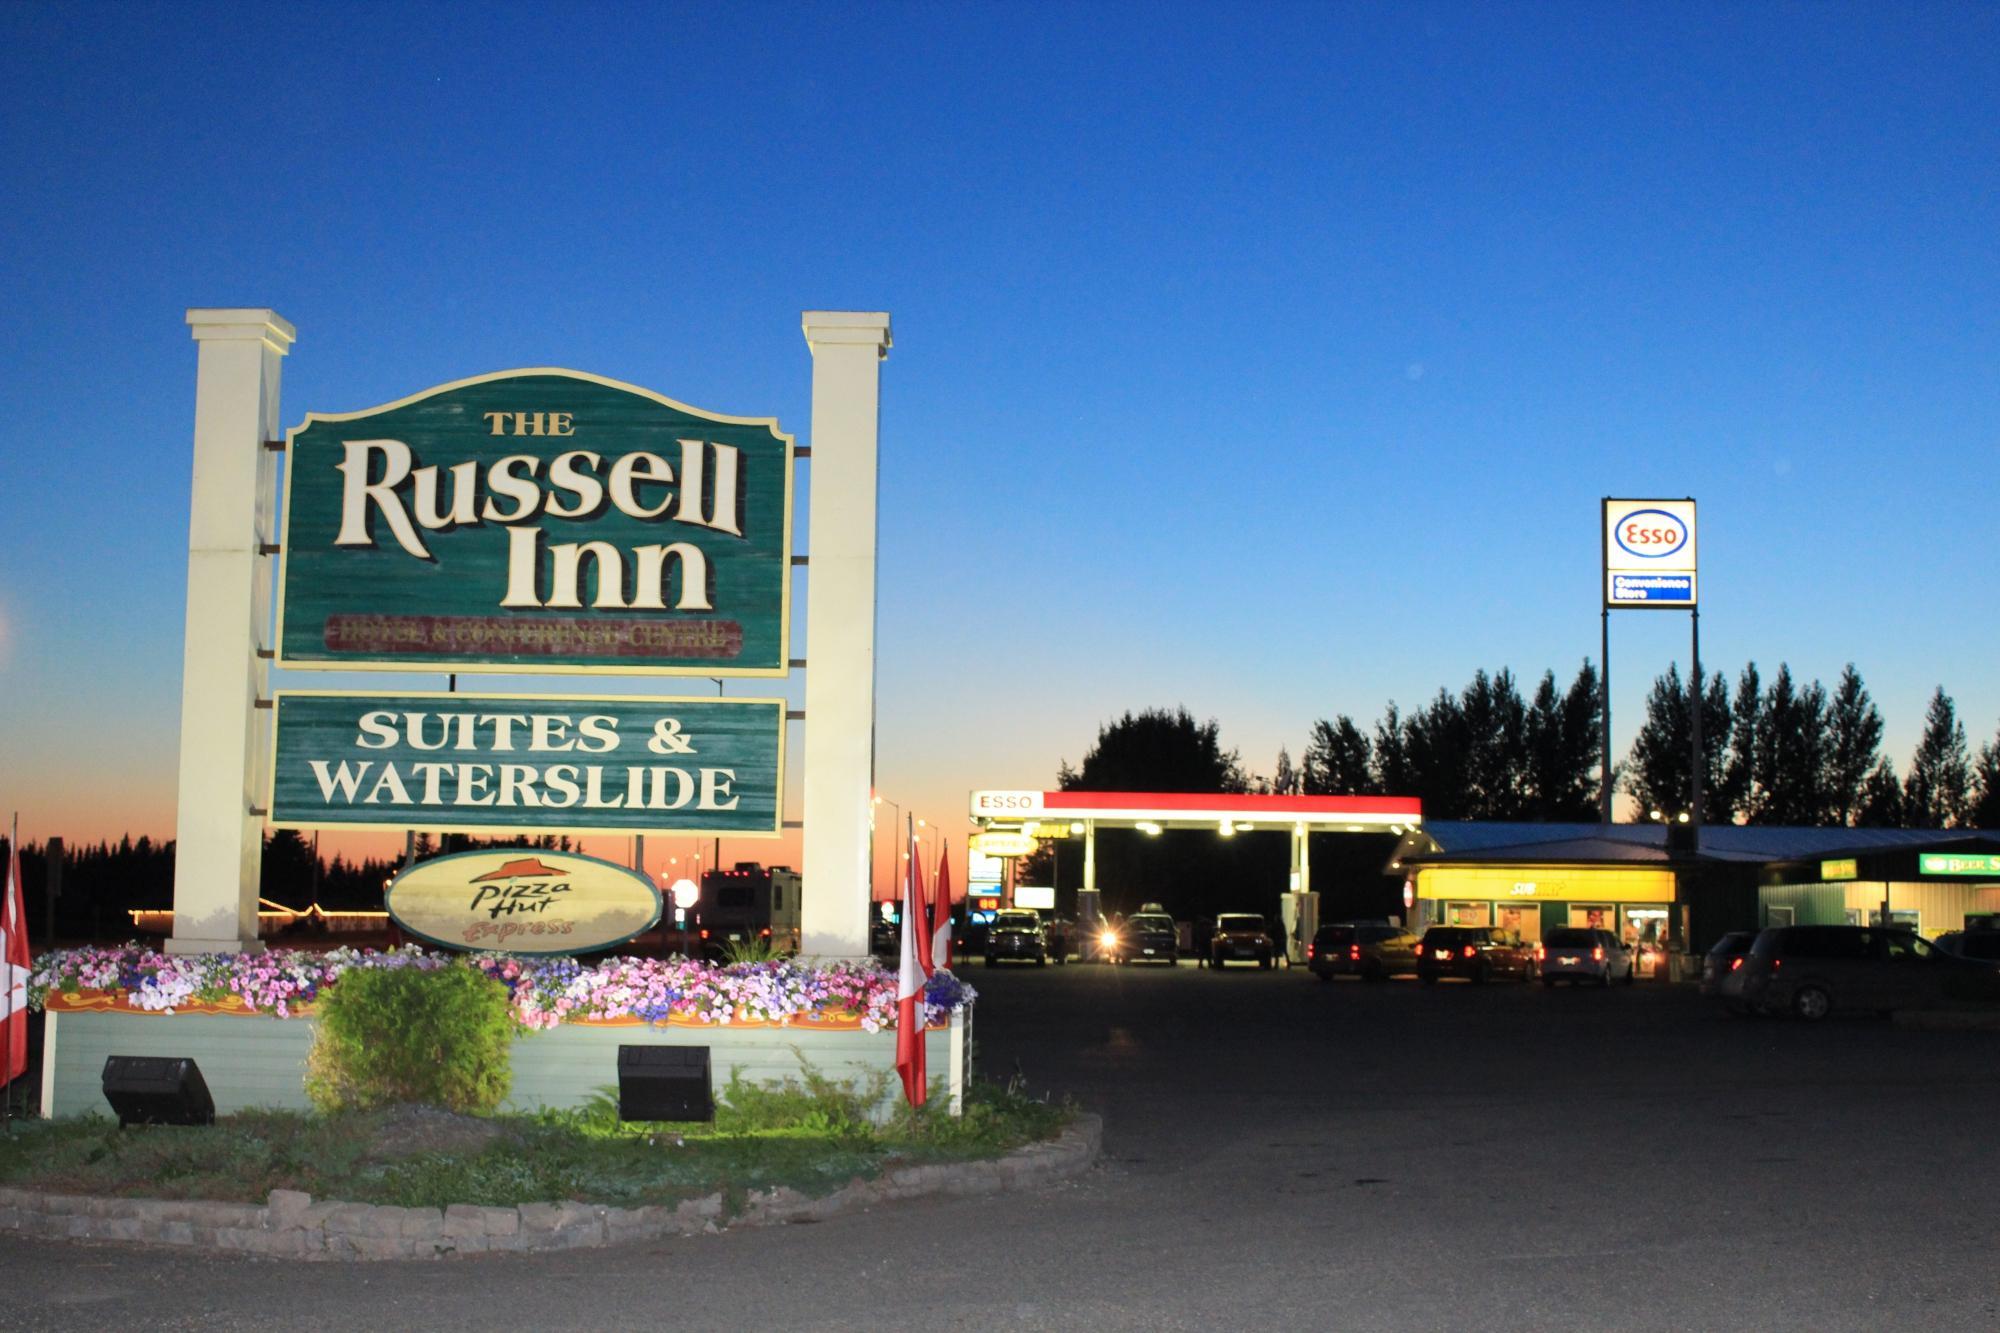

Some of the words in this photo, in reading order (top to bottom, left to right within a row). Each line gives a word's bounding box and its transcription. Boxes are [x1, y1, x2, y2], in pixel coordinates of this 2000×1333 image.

[484, 411, 575, 436] THE
[334, 438, 742, 560] Russell
[499, 526, 713, 610] Inn
[355, 710, 621, 754] SUITES
[647, 717, 697, 754] &
[308, 759, 740, 811] WATERSLIDE
[980, 796, 1033, 808] ESSO
[470, 877, 572, 911] Pizza
[488, 898, 562, 919] Hut
